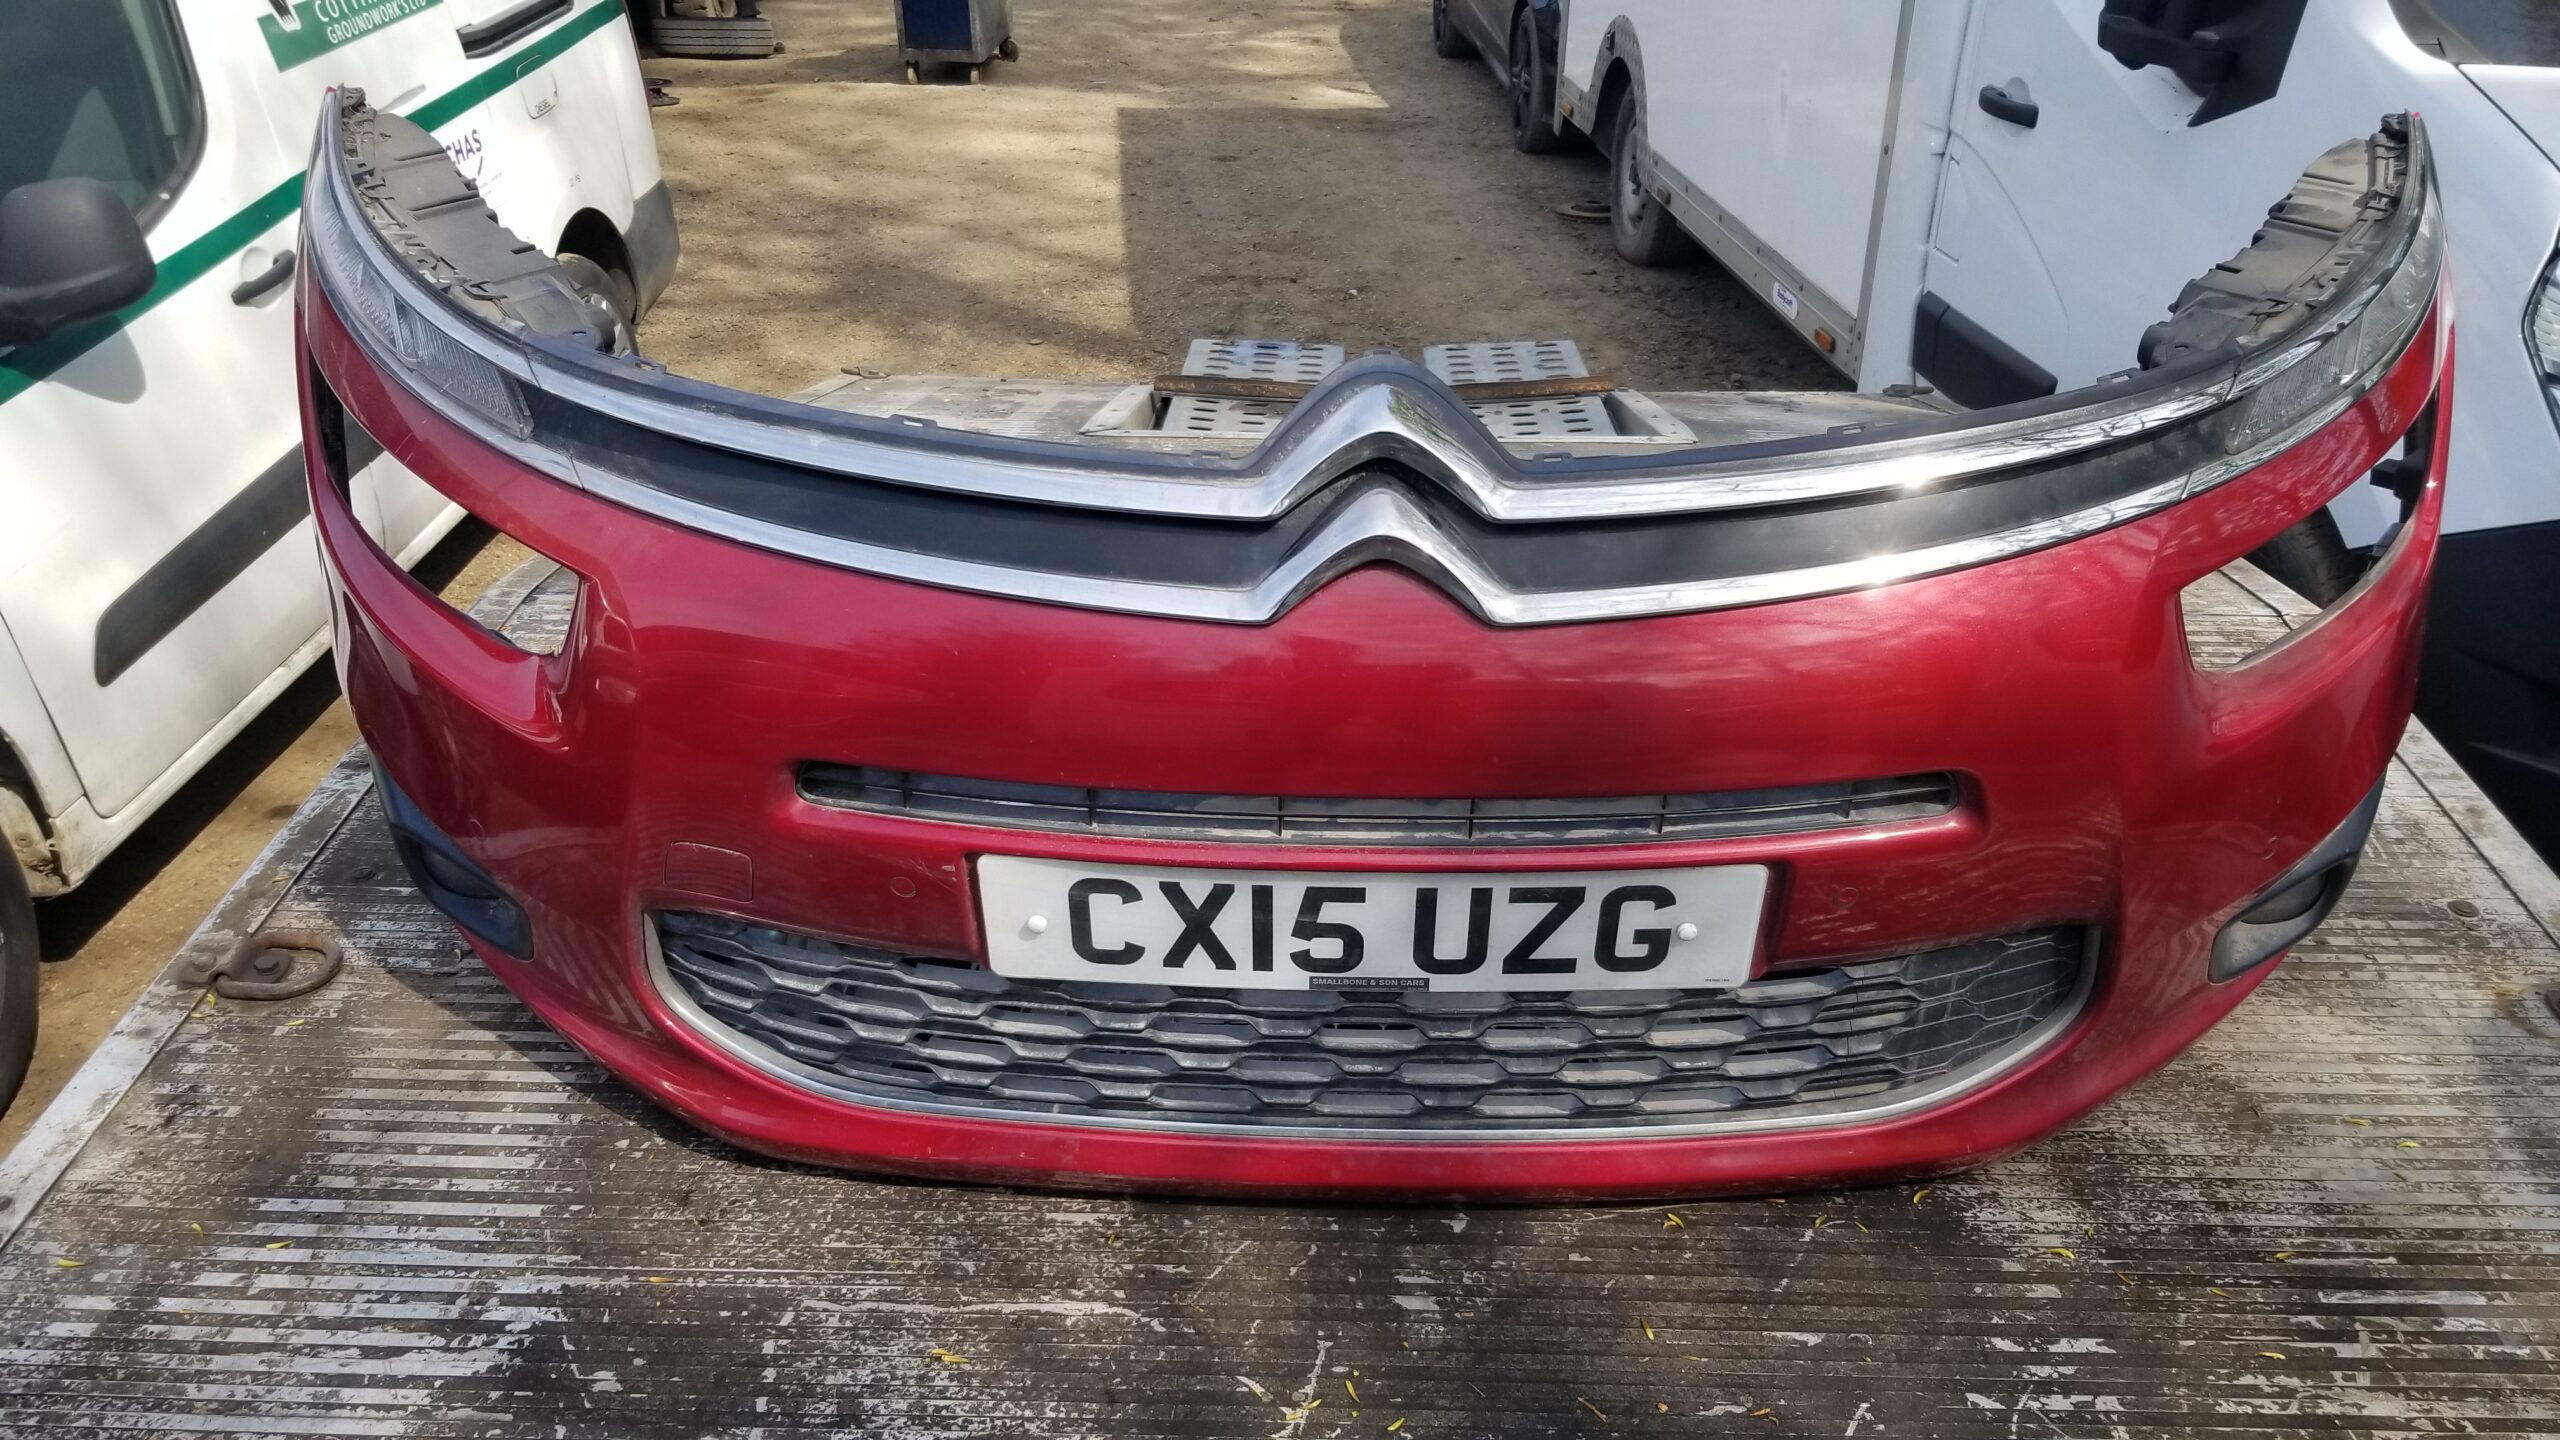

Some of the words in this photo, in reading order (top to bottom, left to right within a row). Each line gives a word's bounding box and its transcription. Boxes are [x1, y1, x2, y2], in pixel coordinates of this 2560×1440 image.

[1068, 877, 1366, 973] CX15
[1412, 885, 1677, 975] UZG
[1312, 978, 1368, 986] SMALLBONE
